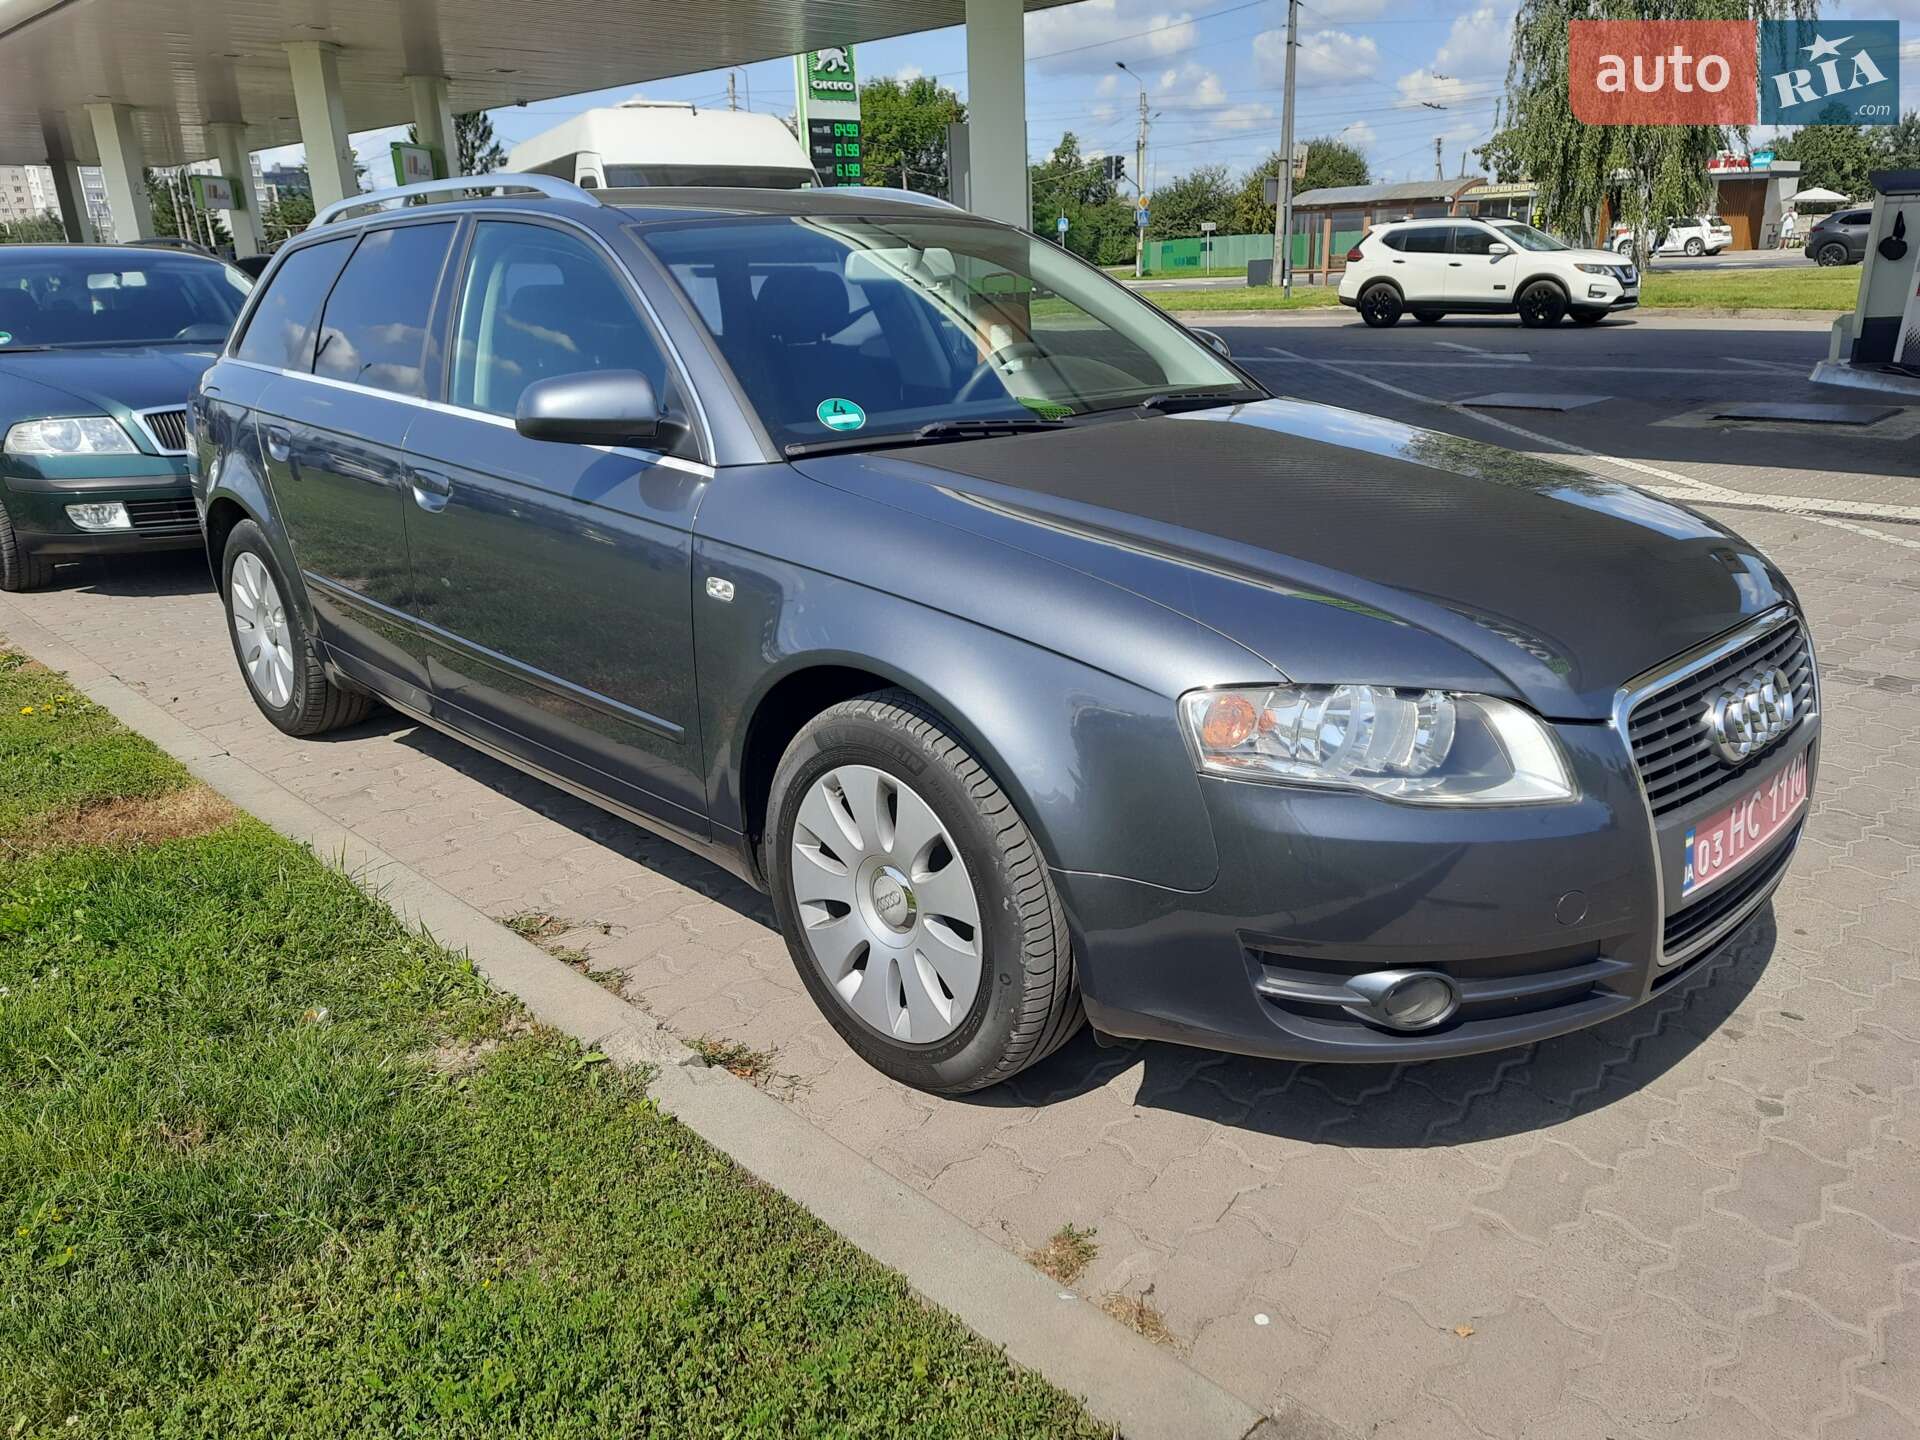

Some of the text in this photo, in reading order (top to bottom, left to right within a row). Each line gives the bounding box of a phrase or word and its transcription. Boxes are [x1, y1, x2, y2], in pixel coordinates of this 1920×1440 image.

[812, 80, 854, 91] OKKO
[833, 400, 846, 415] 4
[1698, 829, 1724, 877] 03
[1729, 790, 1762, 857] HC
